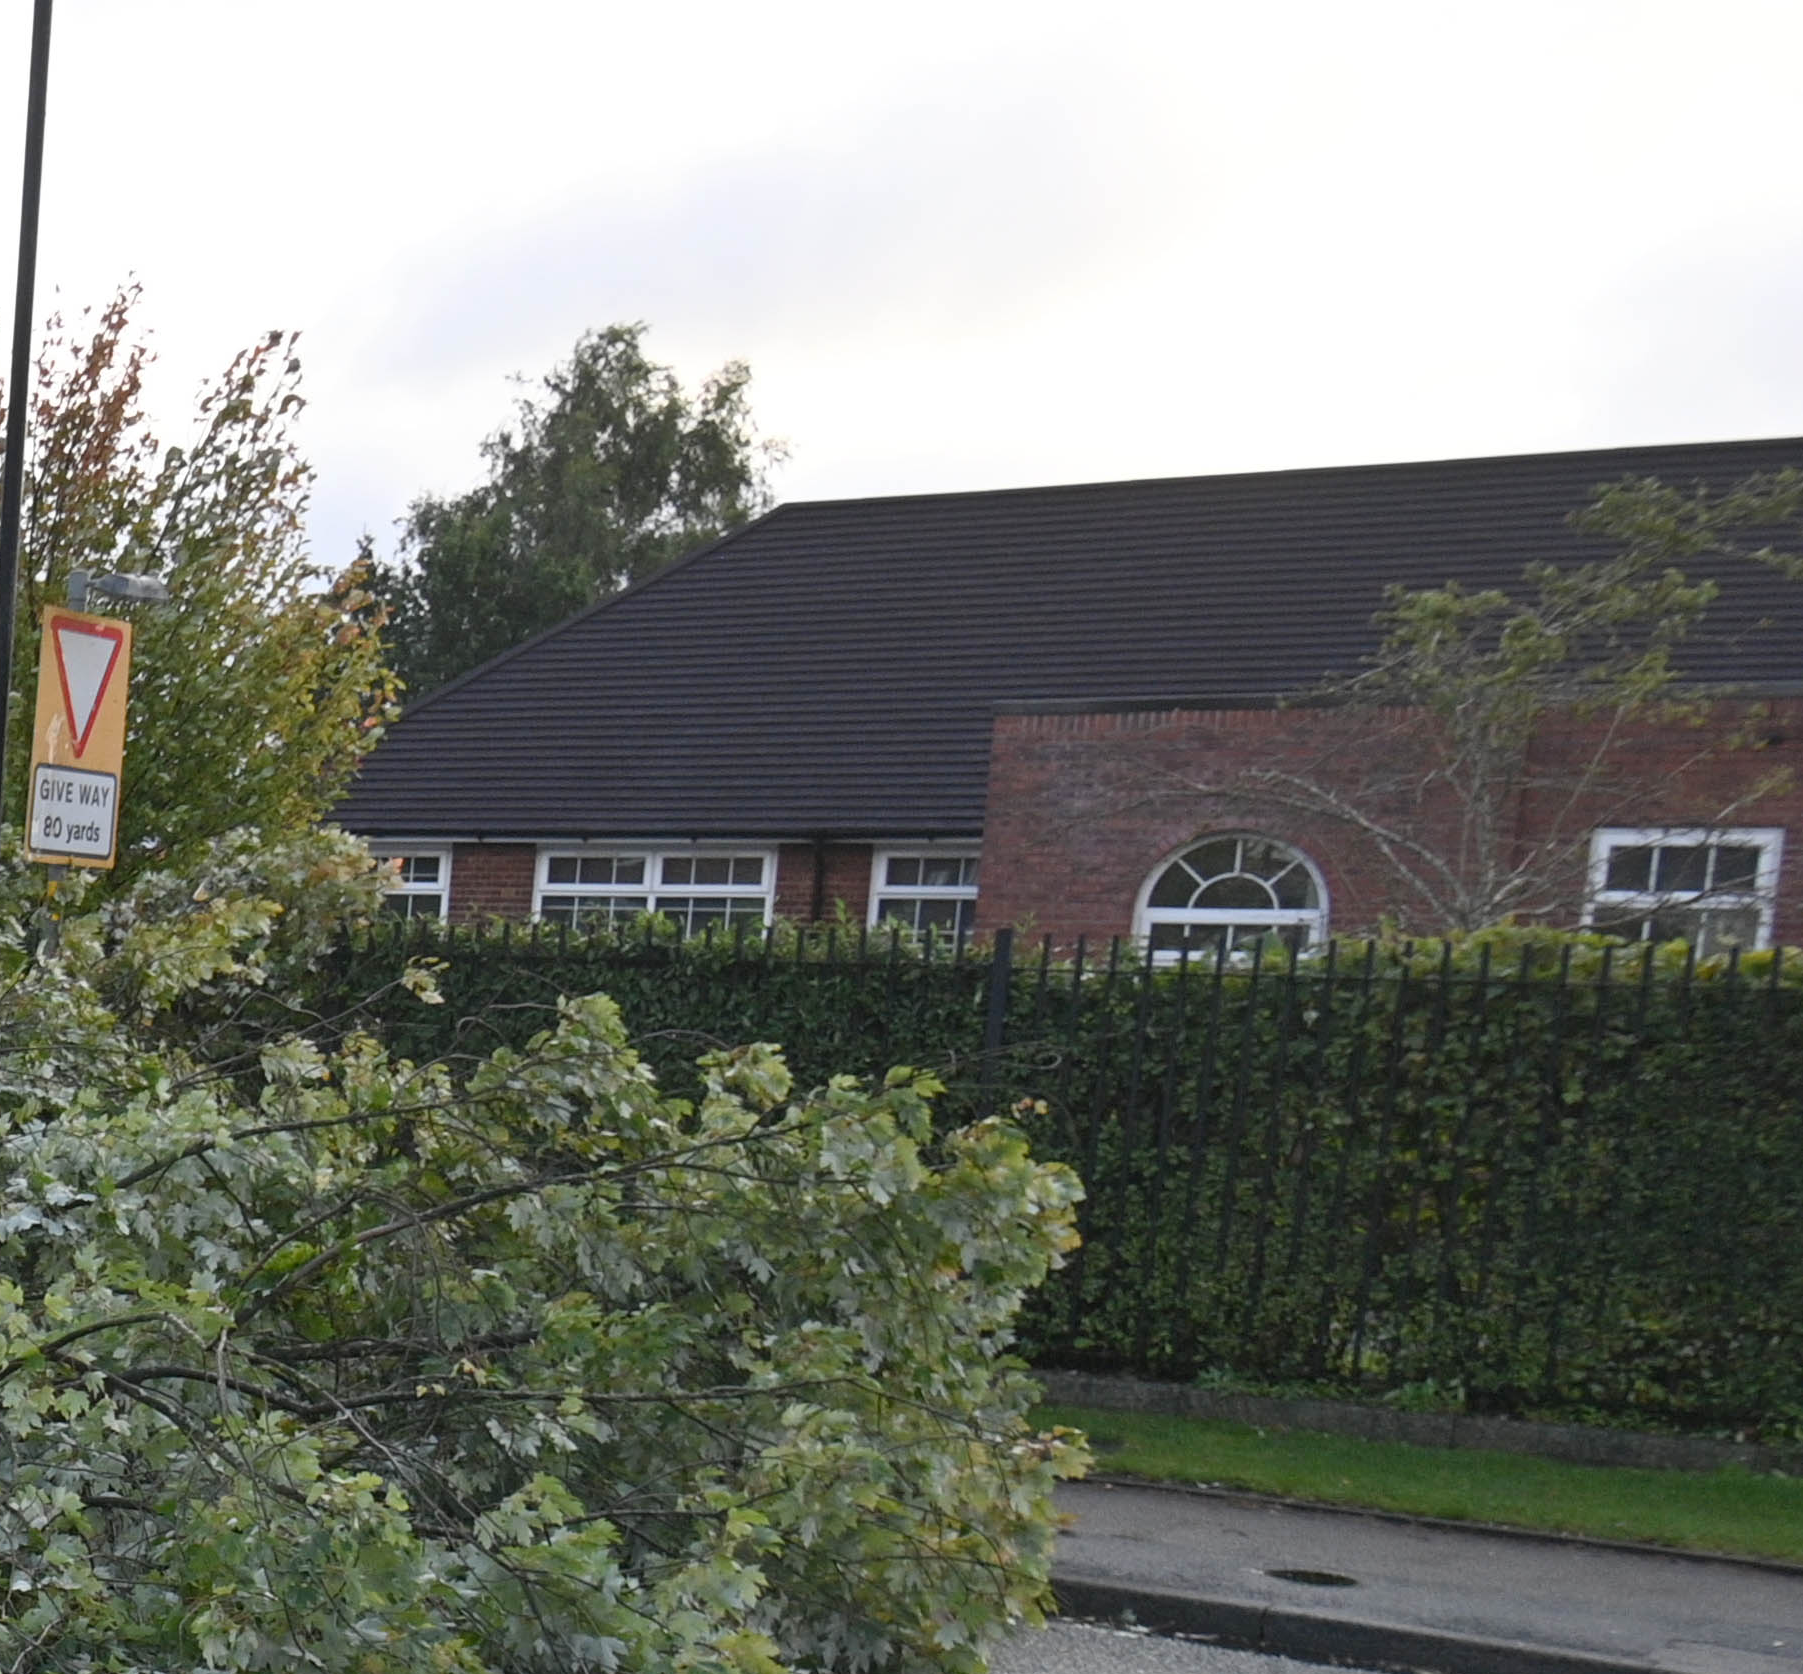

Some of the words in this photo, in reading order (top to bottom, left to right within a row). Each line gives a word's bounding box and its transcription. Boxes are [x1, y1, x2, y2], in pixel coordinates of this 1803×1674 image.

[40, 779, 73, 803] GIVE
[79, 784, 110, 808] WAY
[43, 815, 62, 838] 80
[65, 821, 100, 844] yards
